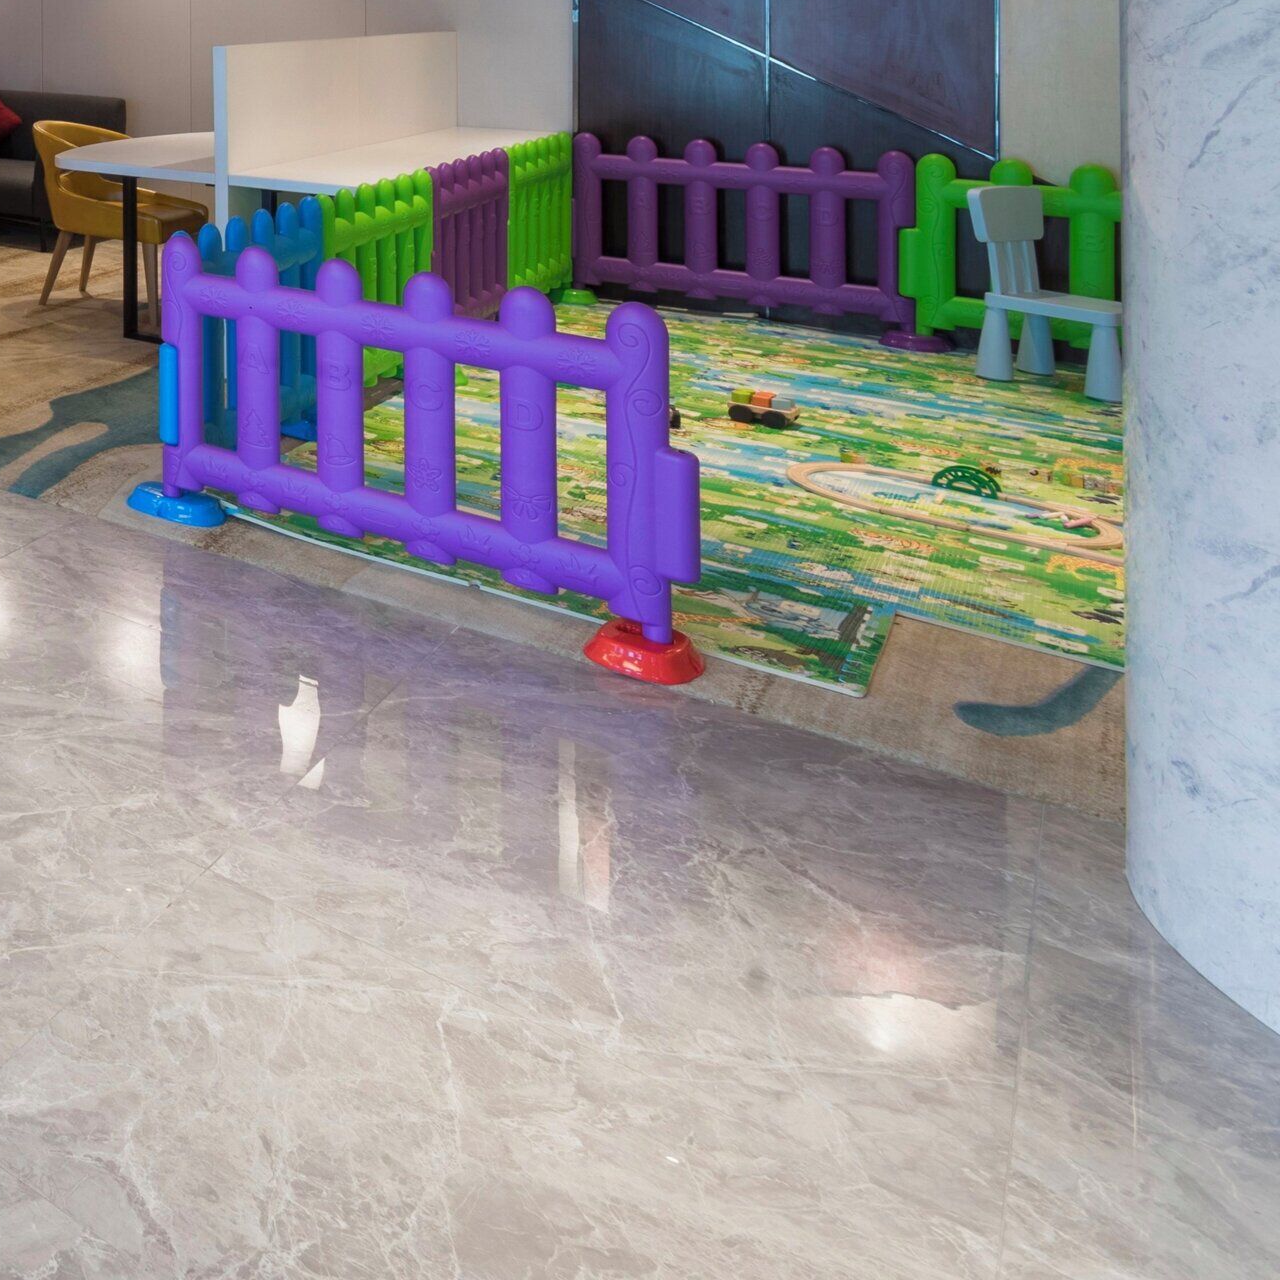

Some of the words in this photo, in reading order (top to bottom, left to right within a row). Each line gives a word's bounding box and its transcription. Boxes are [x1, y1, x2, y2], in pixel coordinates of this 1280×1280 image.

[240, 342, 271, 375] A
[322, 359, 352, 391] B
[408, 378, 445, 411] C
[506, 394, 544, 432] D
